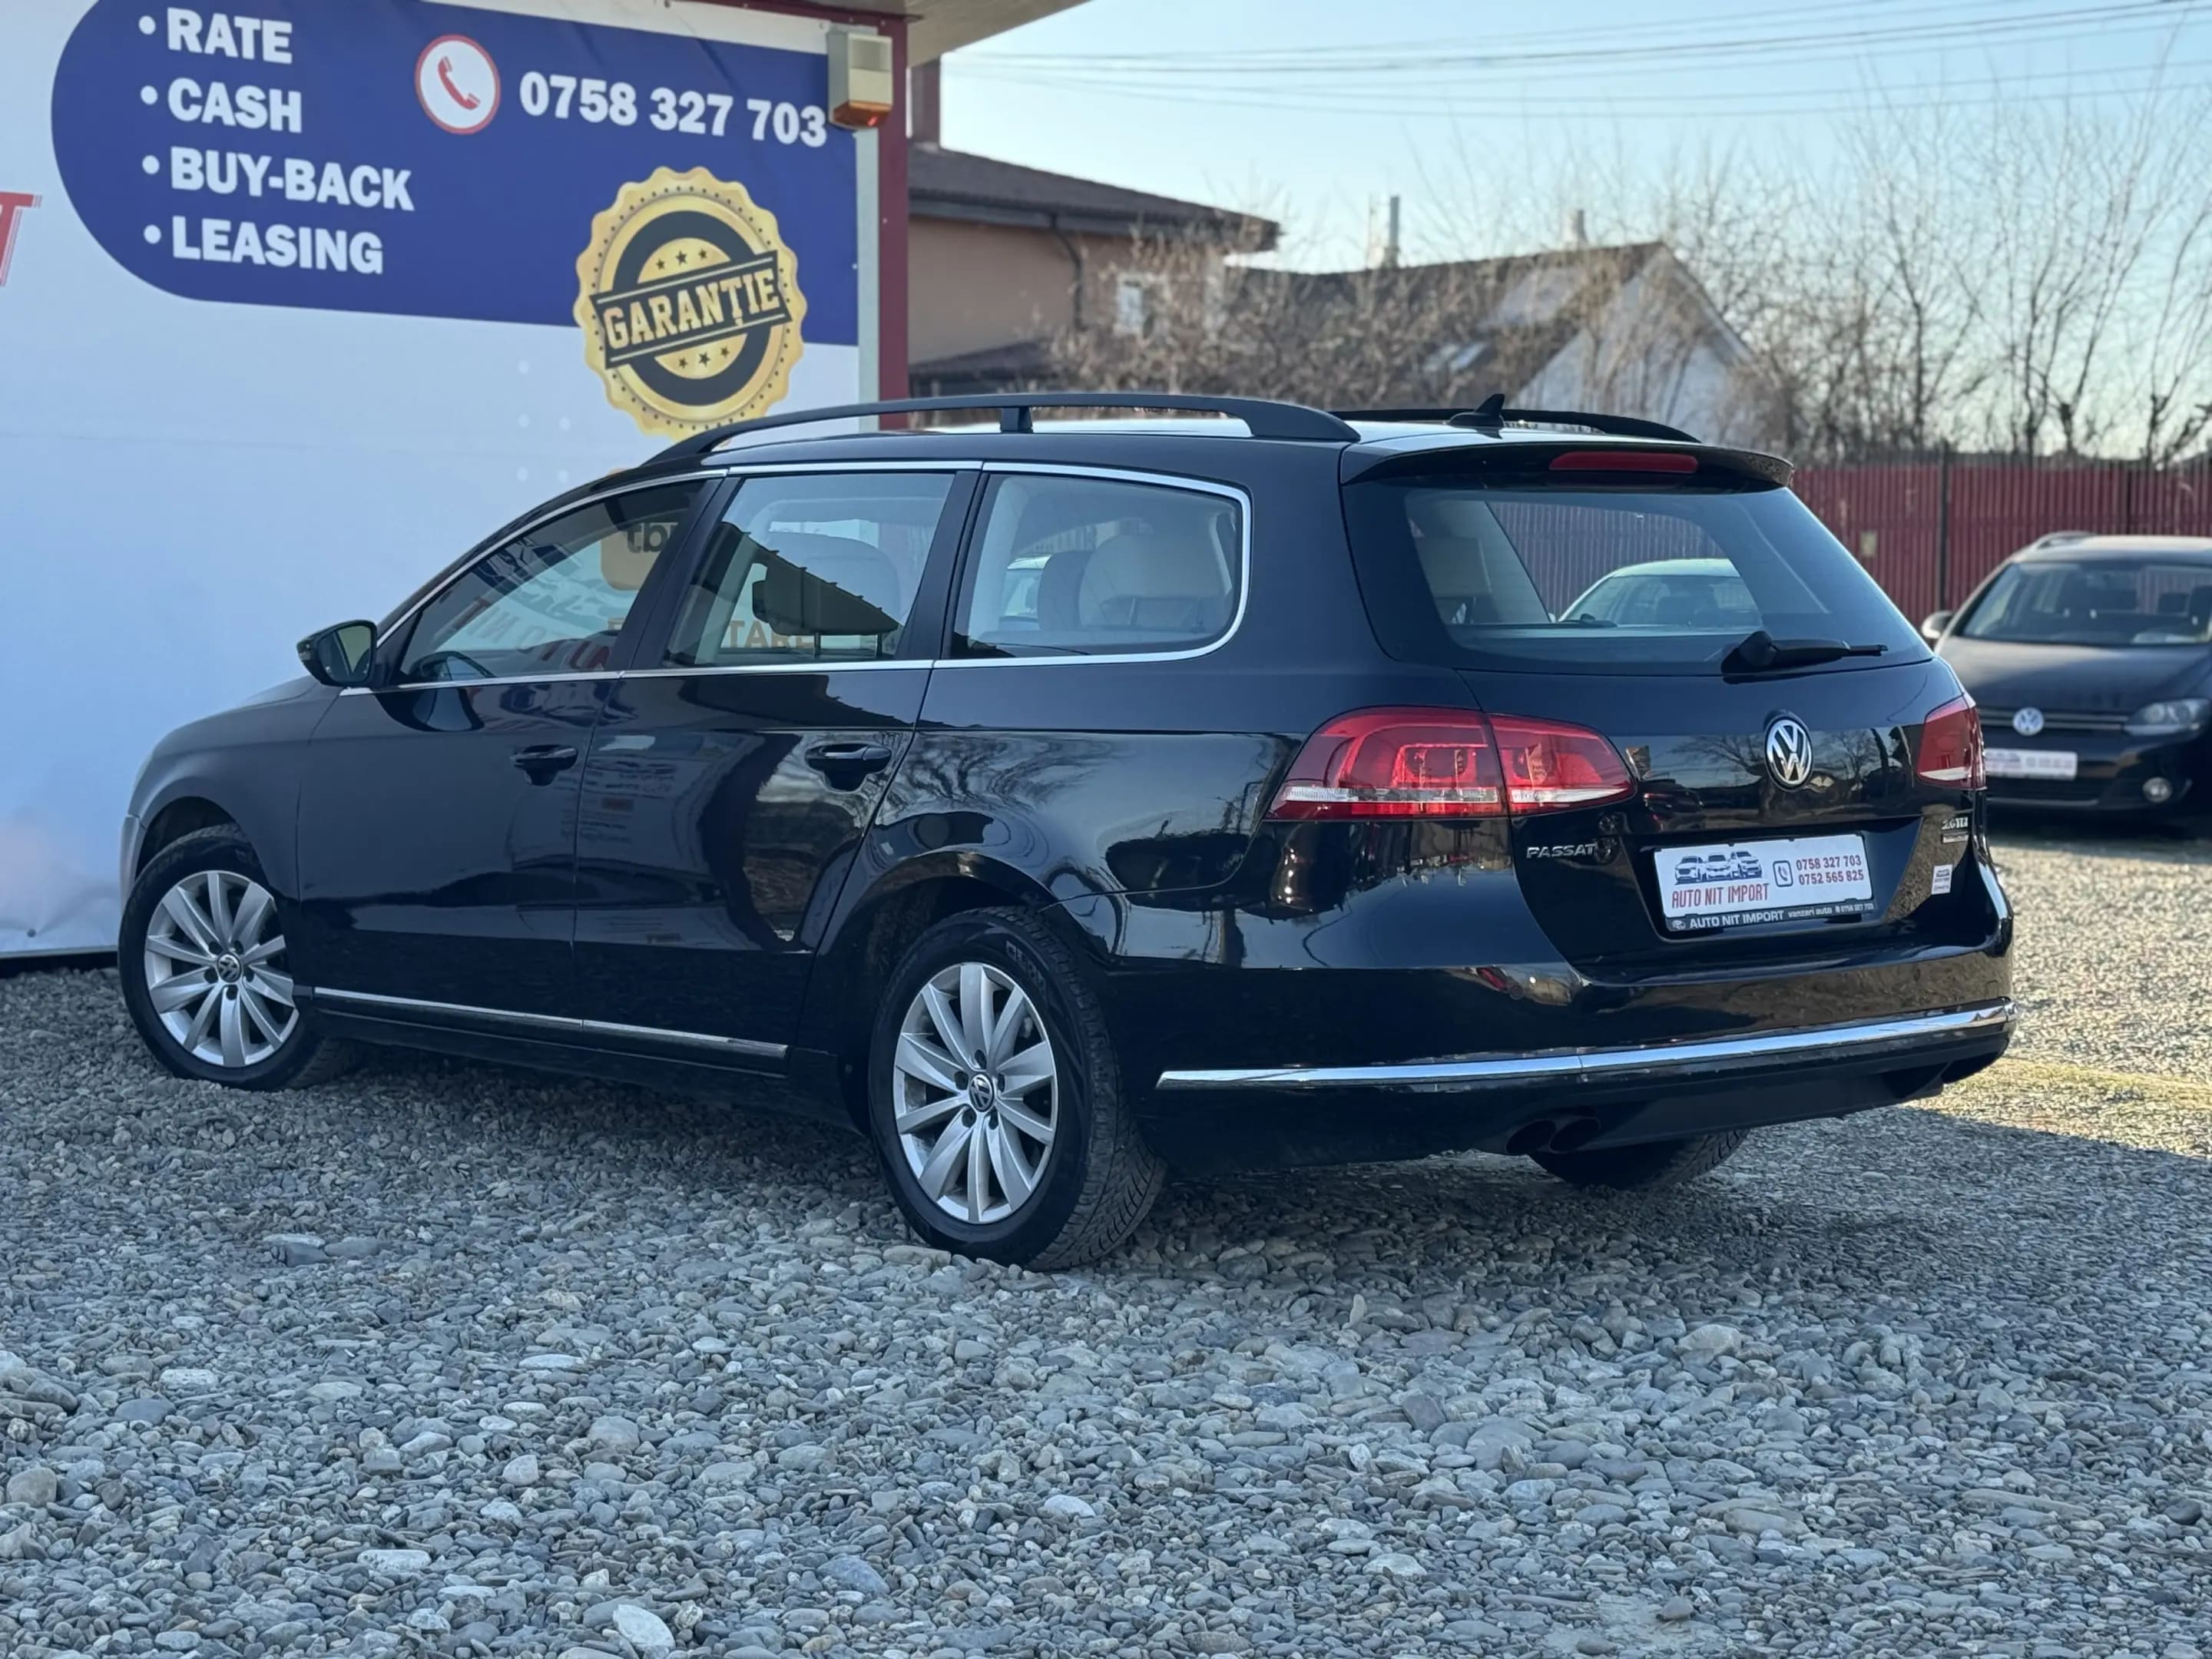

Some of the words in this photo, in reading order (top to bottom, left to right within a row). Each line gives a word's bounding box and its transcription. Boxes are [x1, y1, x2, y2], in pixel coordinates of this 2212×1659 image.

[167, 8, 293, 65] RATE
[167, 78, 302, 133] CASH
[519, 71, 637, 126] 0758
[649, 87, 733, 137] 327
[747, 101, 827, 147] 703
[171, 146, 415, 211] BUY-BACK
[173, 215, 383, 274] LEASING
[1526, 843, 1598, 859] PASSAT
[1796, 859, 1821, 871] 0758
[1823, 856, 1840, 869] 327
[1843, 855, 1862, 867] 703
[1671, 887, 1700, 909] AUTO
[1704, 886, 1724, 906] NIT
[1727, 883, 1770, 903] IMPORT
[1799, 873, 1823, 886] 0752
[1826, 871, 1844, 883] 565
[1846, 869, 1864, 882] 825
[1690, 916, 1720, 929] AUTO
[1722, 914, 1740, 926] NIT
[1742, 910, 1783, 924] IMPORT
